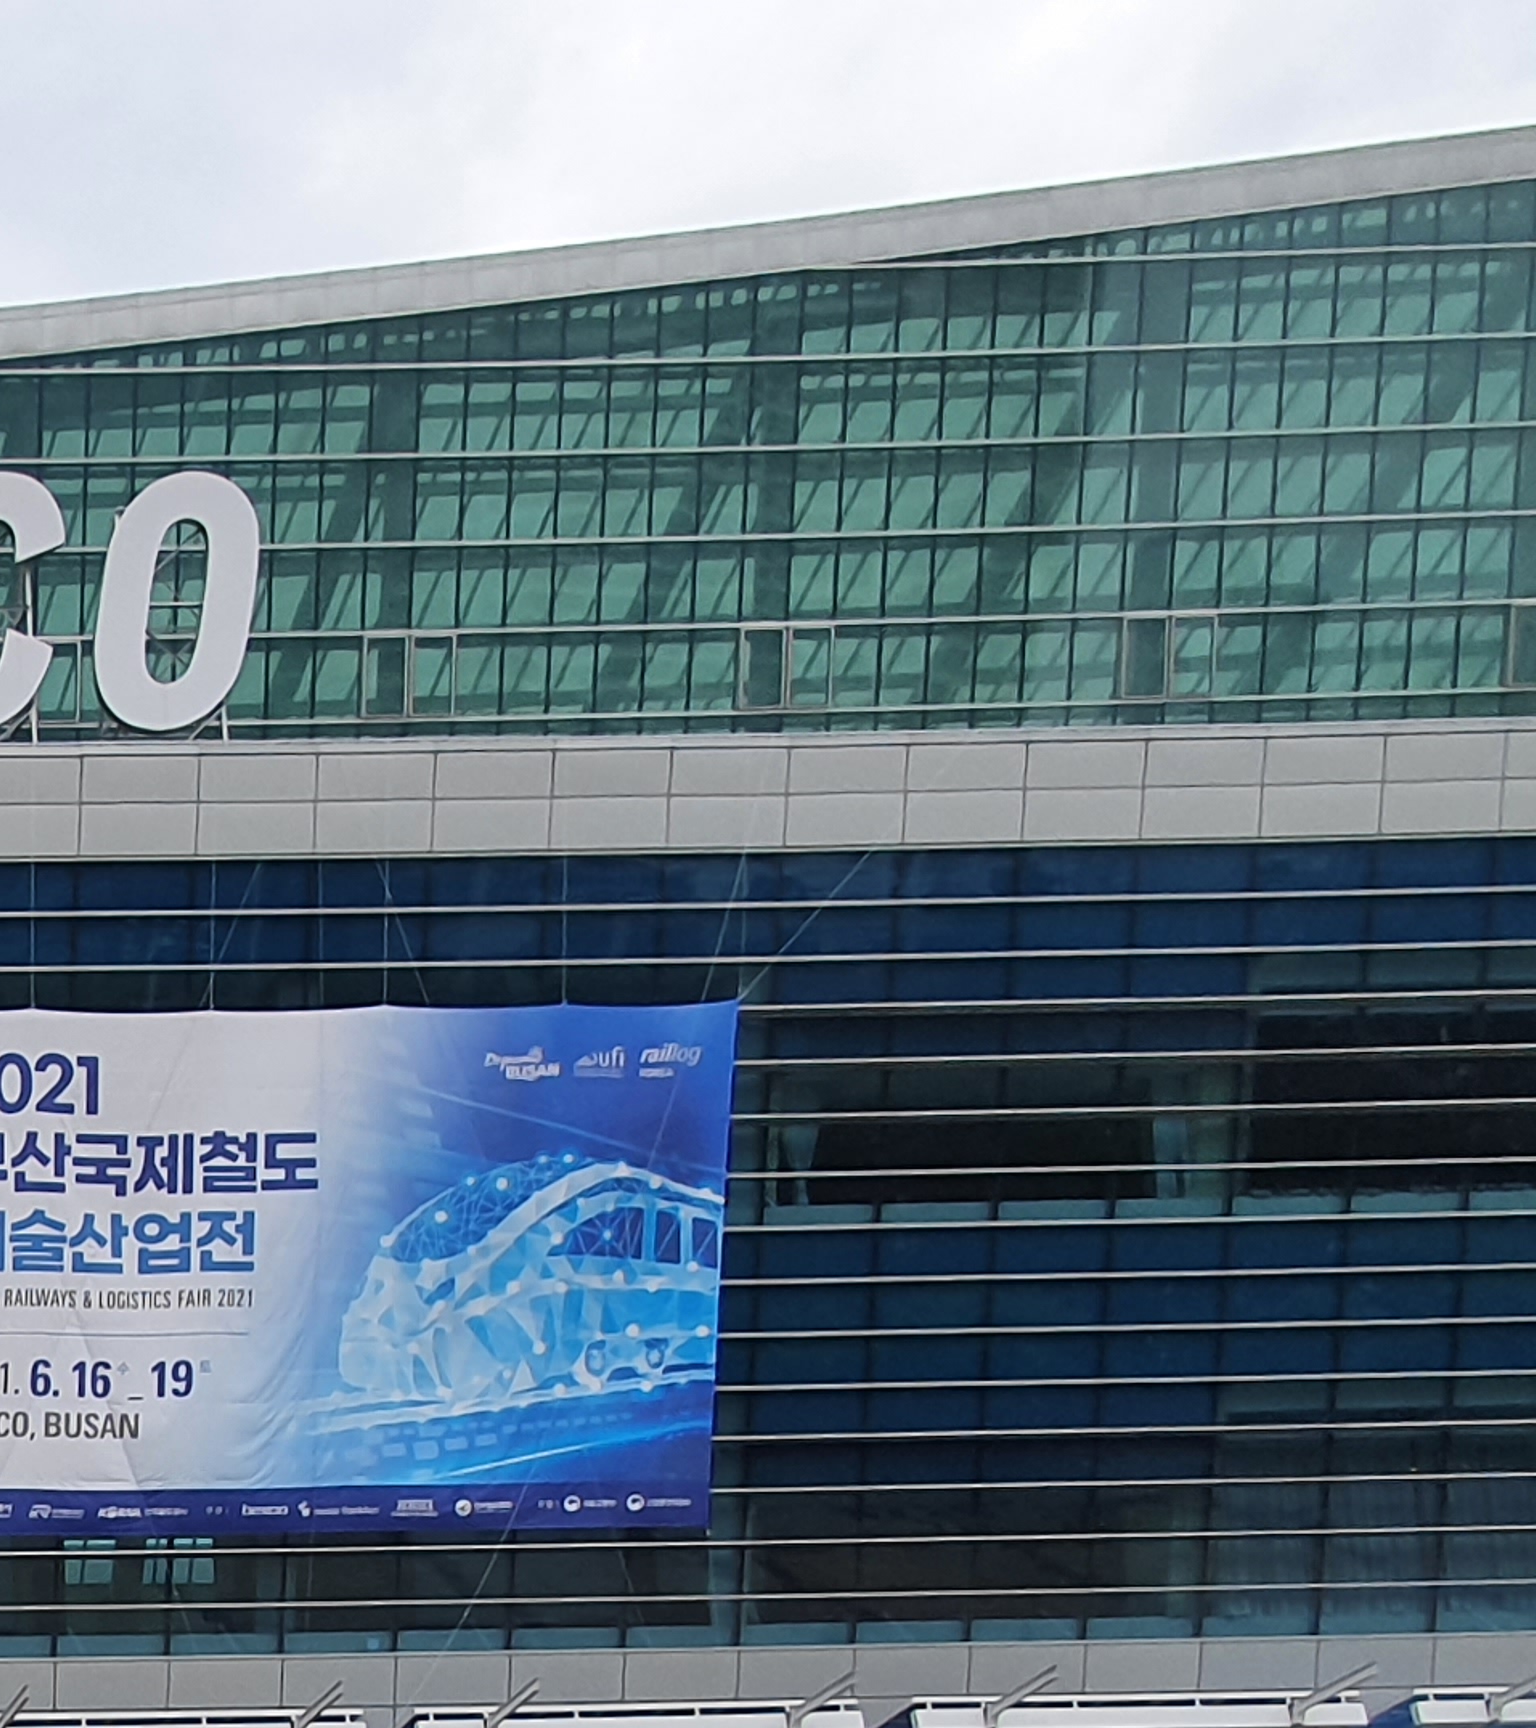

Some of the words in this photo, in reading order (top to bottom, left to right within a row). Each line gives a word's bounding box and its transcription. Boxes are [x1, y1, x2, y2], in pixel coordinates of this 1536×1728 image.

[4, 1289, 76, 1308] RAILWAYS
[83, 1290, 92, 1308] &
[99, 1290, 171, 1309] LOGISTICS
[178, 1289, 211, 1308] FAIR
[217, 1288, 253, 1308] 2021
[30, 1359, 60, 1397] 6.
[44, 1412, 139, 1439] BUSAN
